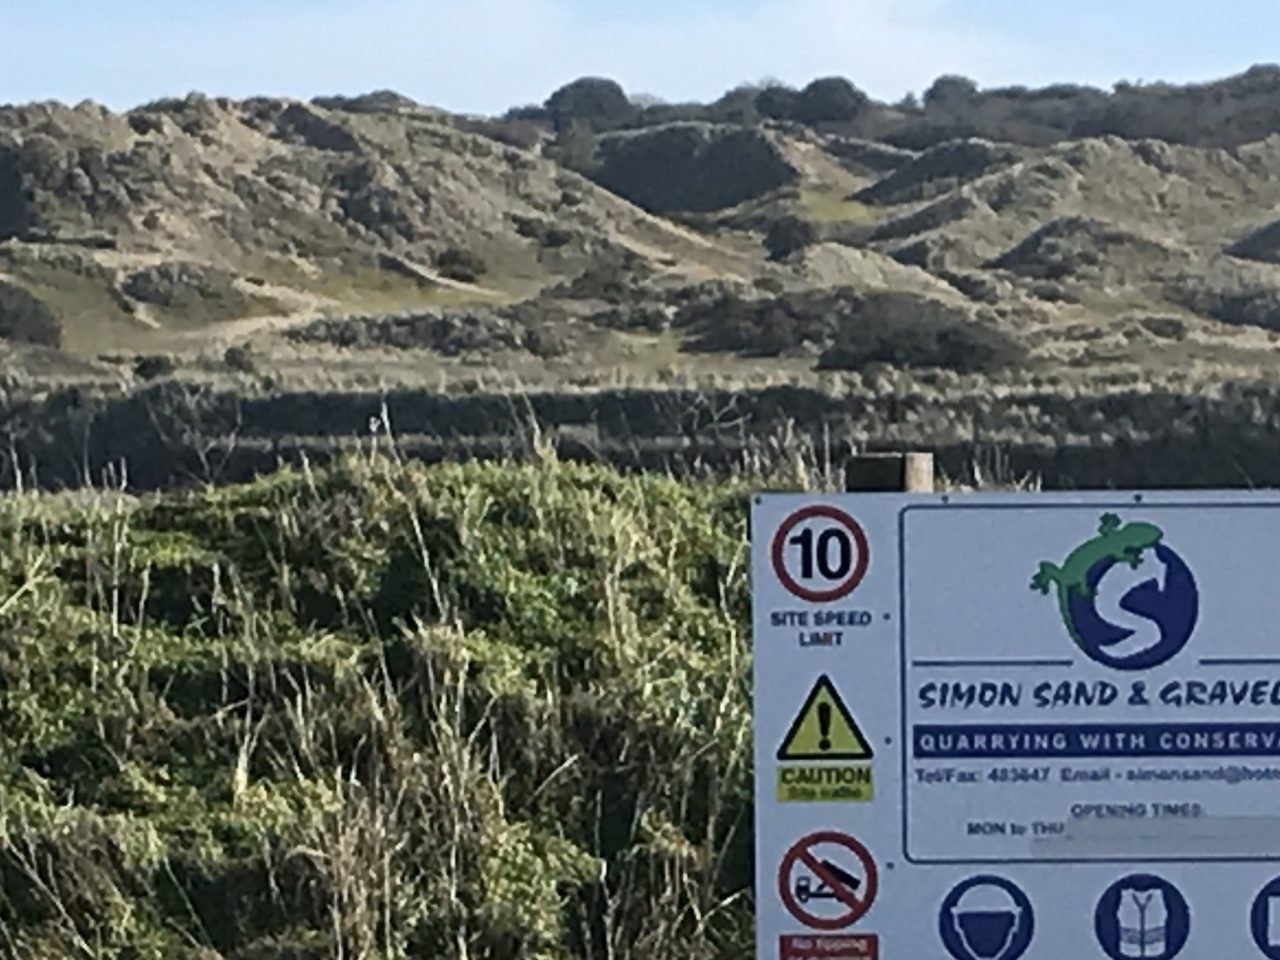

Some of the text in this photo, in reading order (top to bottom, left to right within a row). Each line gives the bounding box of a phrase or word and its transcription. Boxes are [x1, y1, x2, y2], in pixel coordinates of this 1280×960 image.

[789, 527, 851, 580] 10
[770, 611, 872, 626] SITE SPEED
[799, 632, 843, 646] LIMIT
[918, 681, 1022, 709] SIMON
[1033, 680, 1119, 709] SAND
[1127, 680, 1150, 706] &
[919, 733, 1067, 750] QUARRYING
[1079, 733, 1146, 749] WITH
[781, 766, 871, 785] CAUTION
[1060, 768, 1110, 782] Email
[1070, 803, 1147, 818] OPENING
[967, 822, 1006, 836] MON
